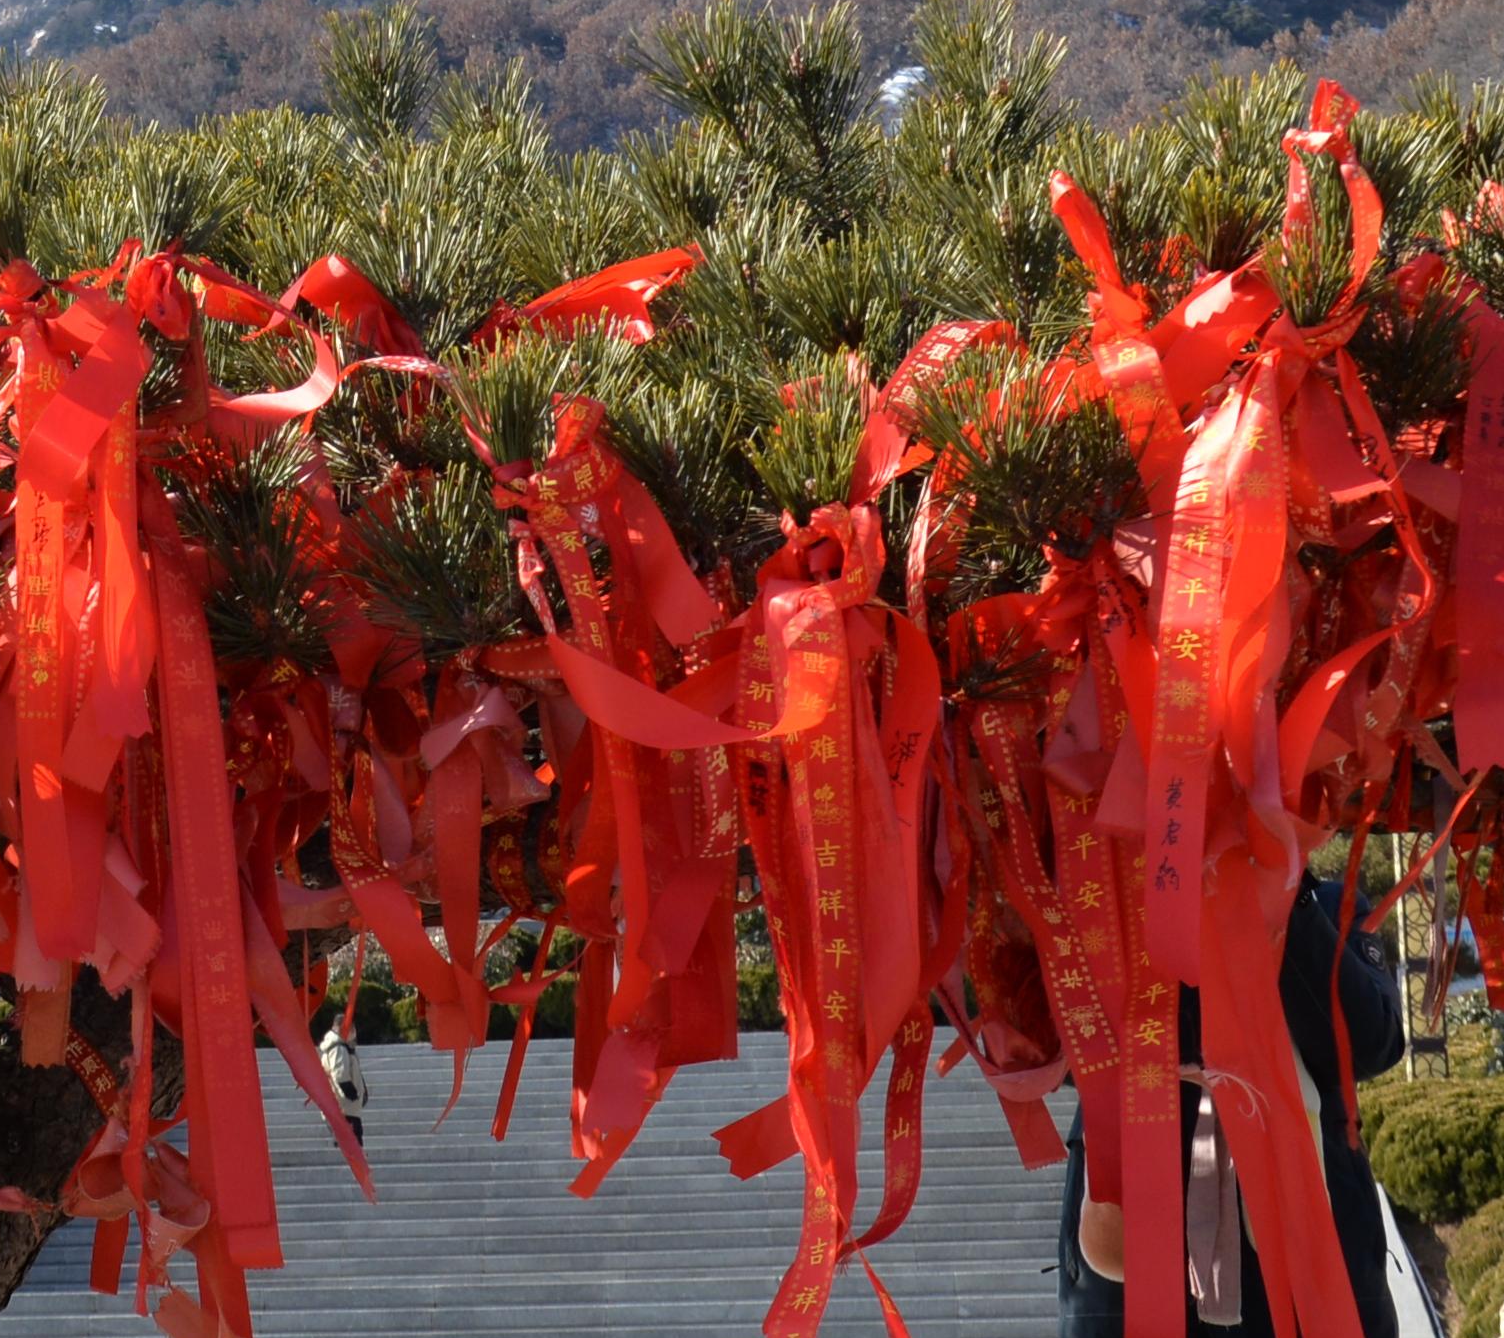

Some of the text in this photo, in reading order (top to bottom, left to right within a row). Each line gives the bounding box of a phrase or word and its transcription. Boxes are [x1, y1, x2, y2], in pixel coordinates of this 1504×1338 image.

[1169, 477, 1214, 662] 吉祥平安
[813, 838, 852, 1022] 吉祥平安
[892, 1020, 924, 1141] 比南山
